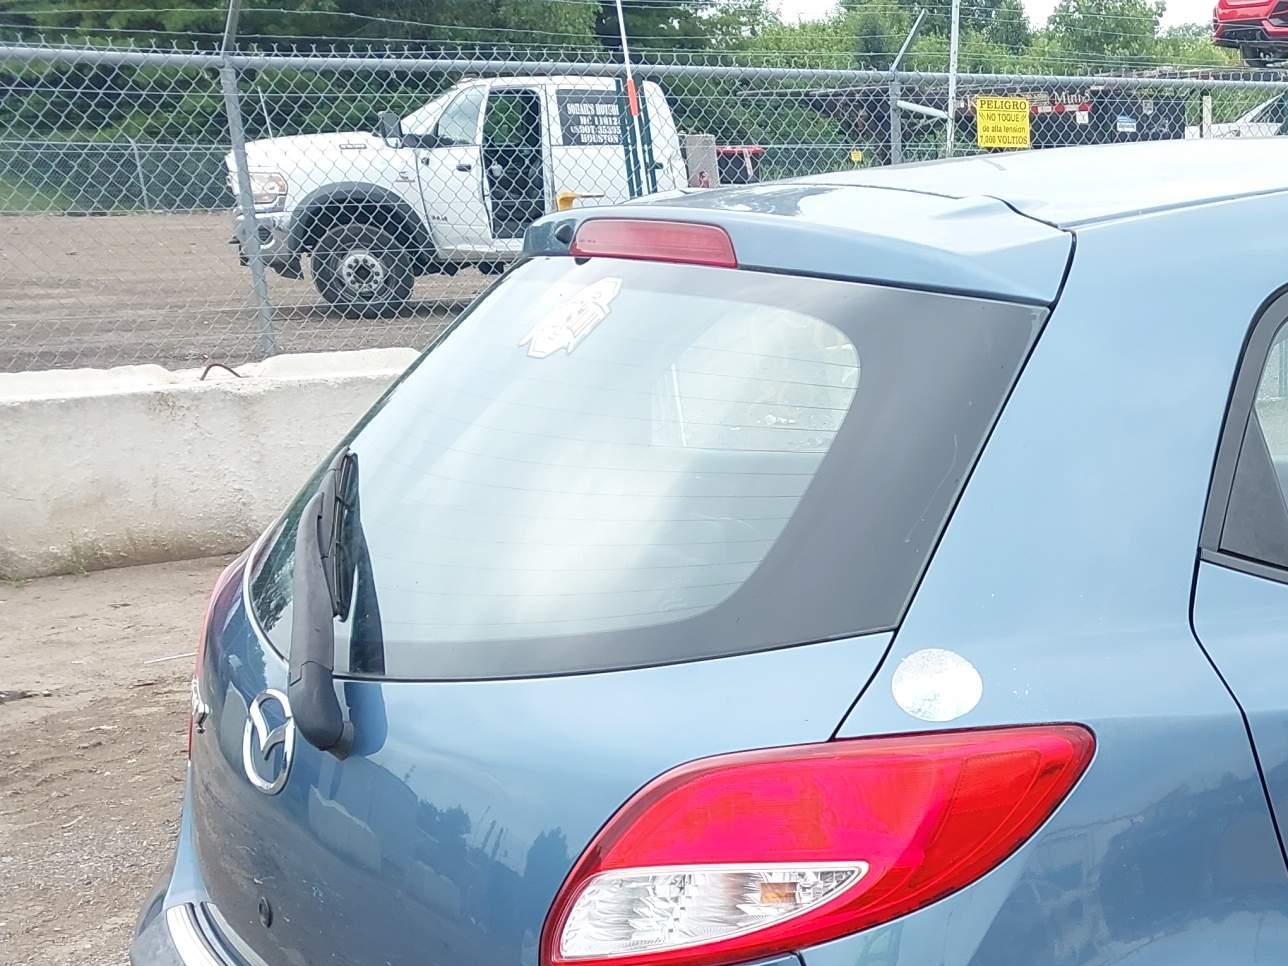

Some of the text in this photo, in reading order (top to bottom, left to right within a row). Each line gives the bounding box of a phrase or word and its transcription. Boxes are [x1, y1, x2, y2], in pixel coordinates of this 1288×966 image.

[980, 99, 1027, 111] PELIGRO
[986, 113, 996, 122] NO
[997, 135, 1028, 145] VOLTIOS
